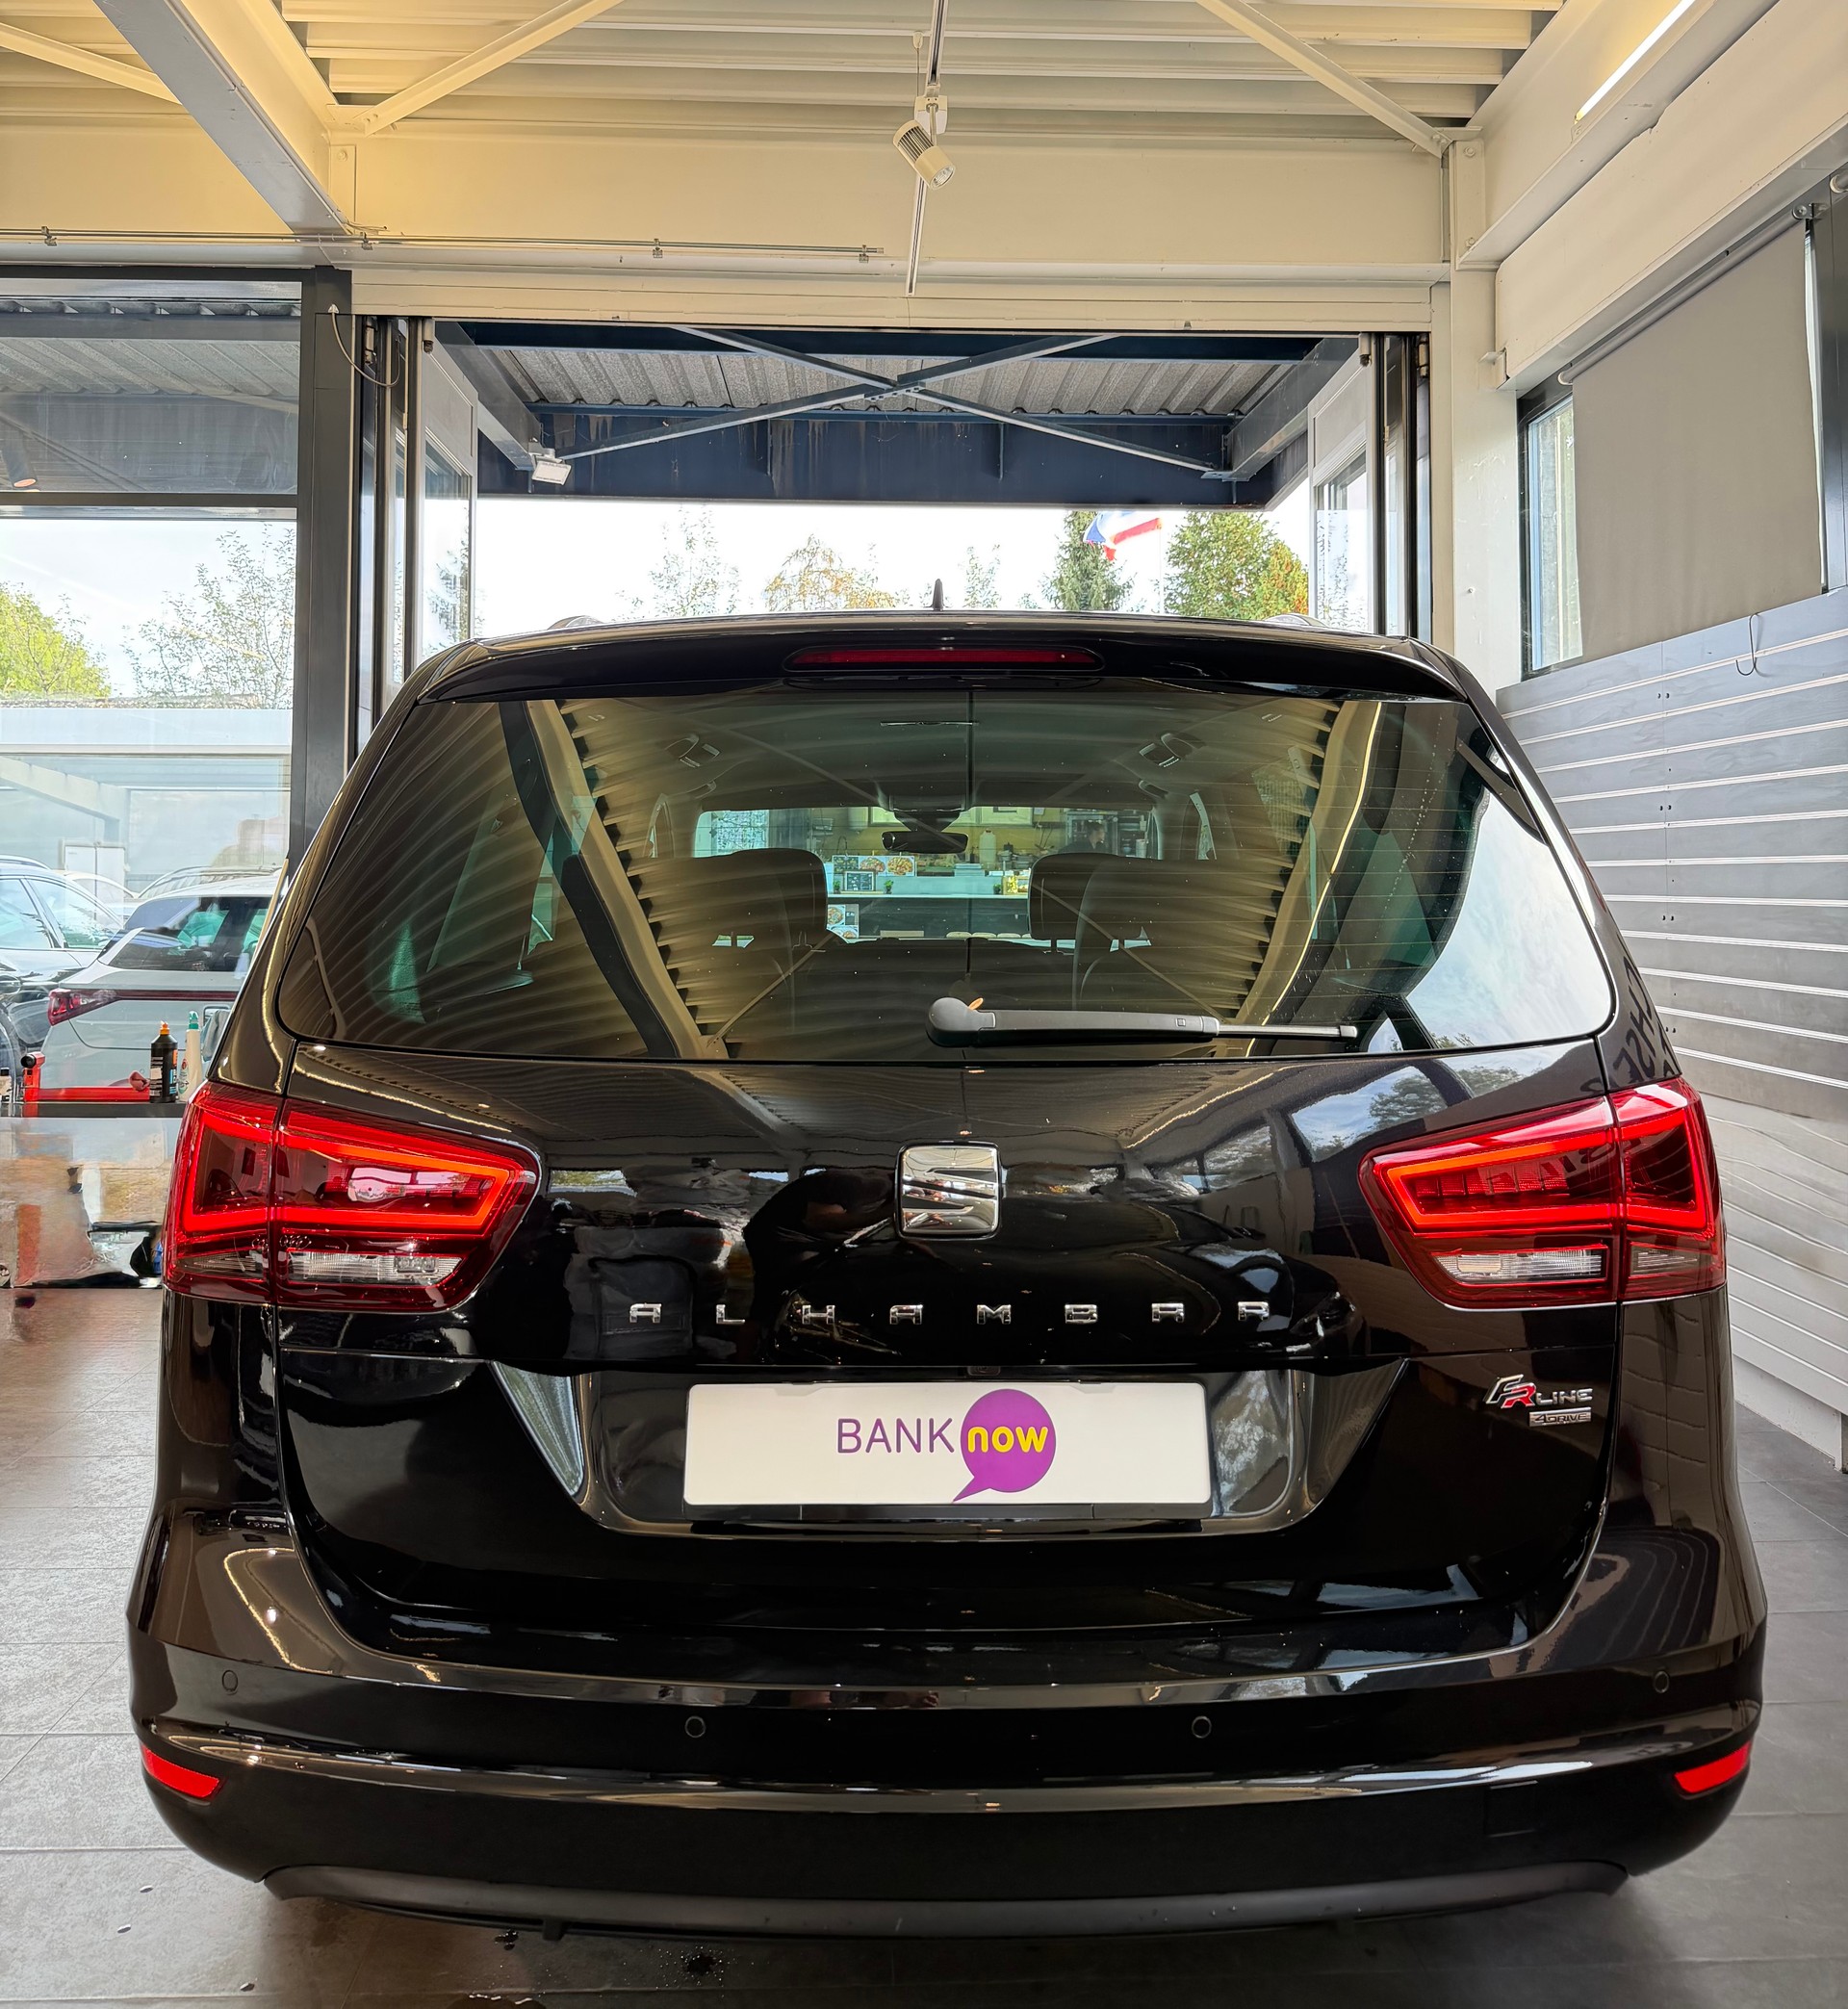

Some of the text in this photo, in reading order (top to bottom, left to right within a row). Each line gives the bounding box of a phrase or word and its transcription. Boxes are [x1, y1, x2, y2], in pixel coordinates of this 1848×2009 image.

[629, 1301, 1270, 1325] ALHAMBRA
[1536, 1388, 1593, 1406] LINE
[1534, 1412, 1588, 1425] 4DRIVE
[837, 1417, 1049, 1454] BANK now
